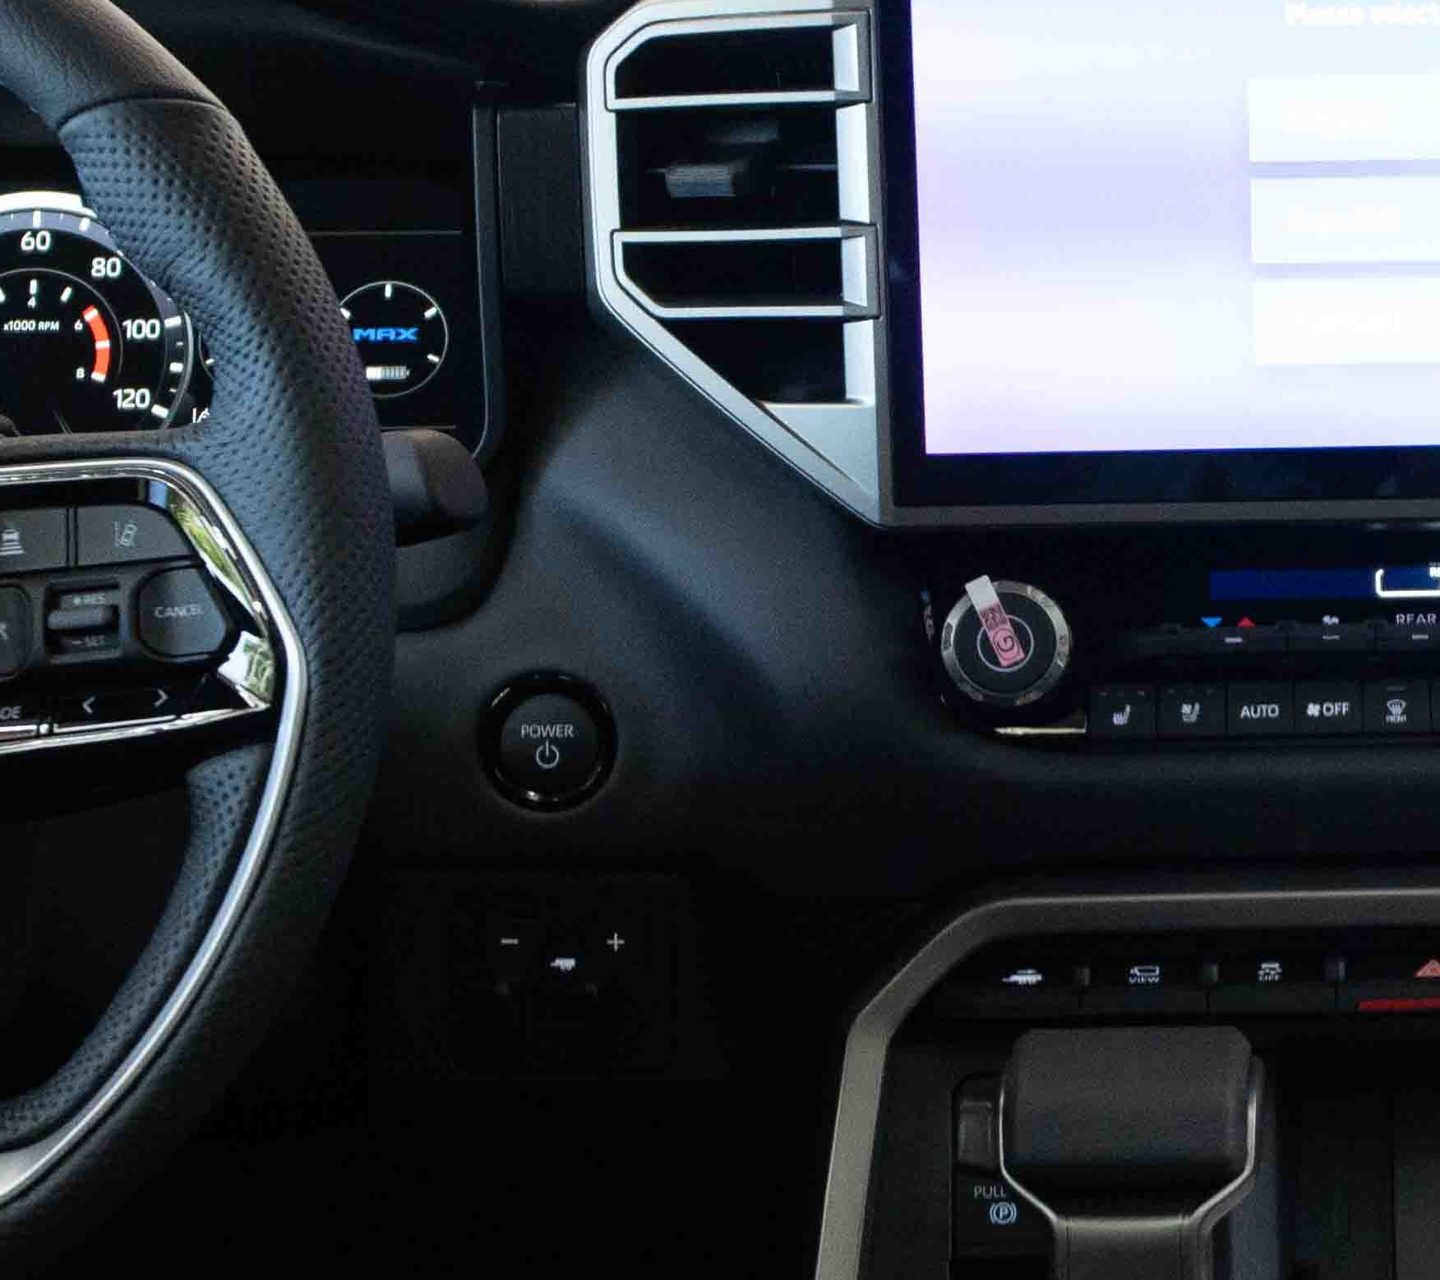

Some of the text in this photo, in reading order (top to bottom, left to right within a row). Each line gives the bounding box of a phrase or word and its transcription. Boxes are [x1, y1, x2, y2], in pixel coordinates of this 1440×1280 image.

[20, 231, 51, 252] 60
[91, 257, 122, 278] 80
[27, 297, 37, 308] 4
[3, 320, 60, 331] x1000 RPM
[74, 320, 84, 331] 6
[122, 320, 160, 340] 100
[352, 326, 420, 341] MAX
[112, 388, 150, 409] 120
[1240, 703, 1280, 718] AUTO
[1322, 701, 1350, 717] OFF
[520, 723, 575, 739] POWER
[974, 1184, 1007, 1200] PULL
